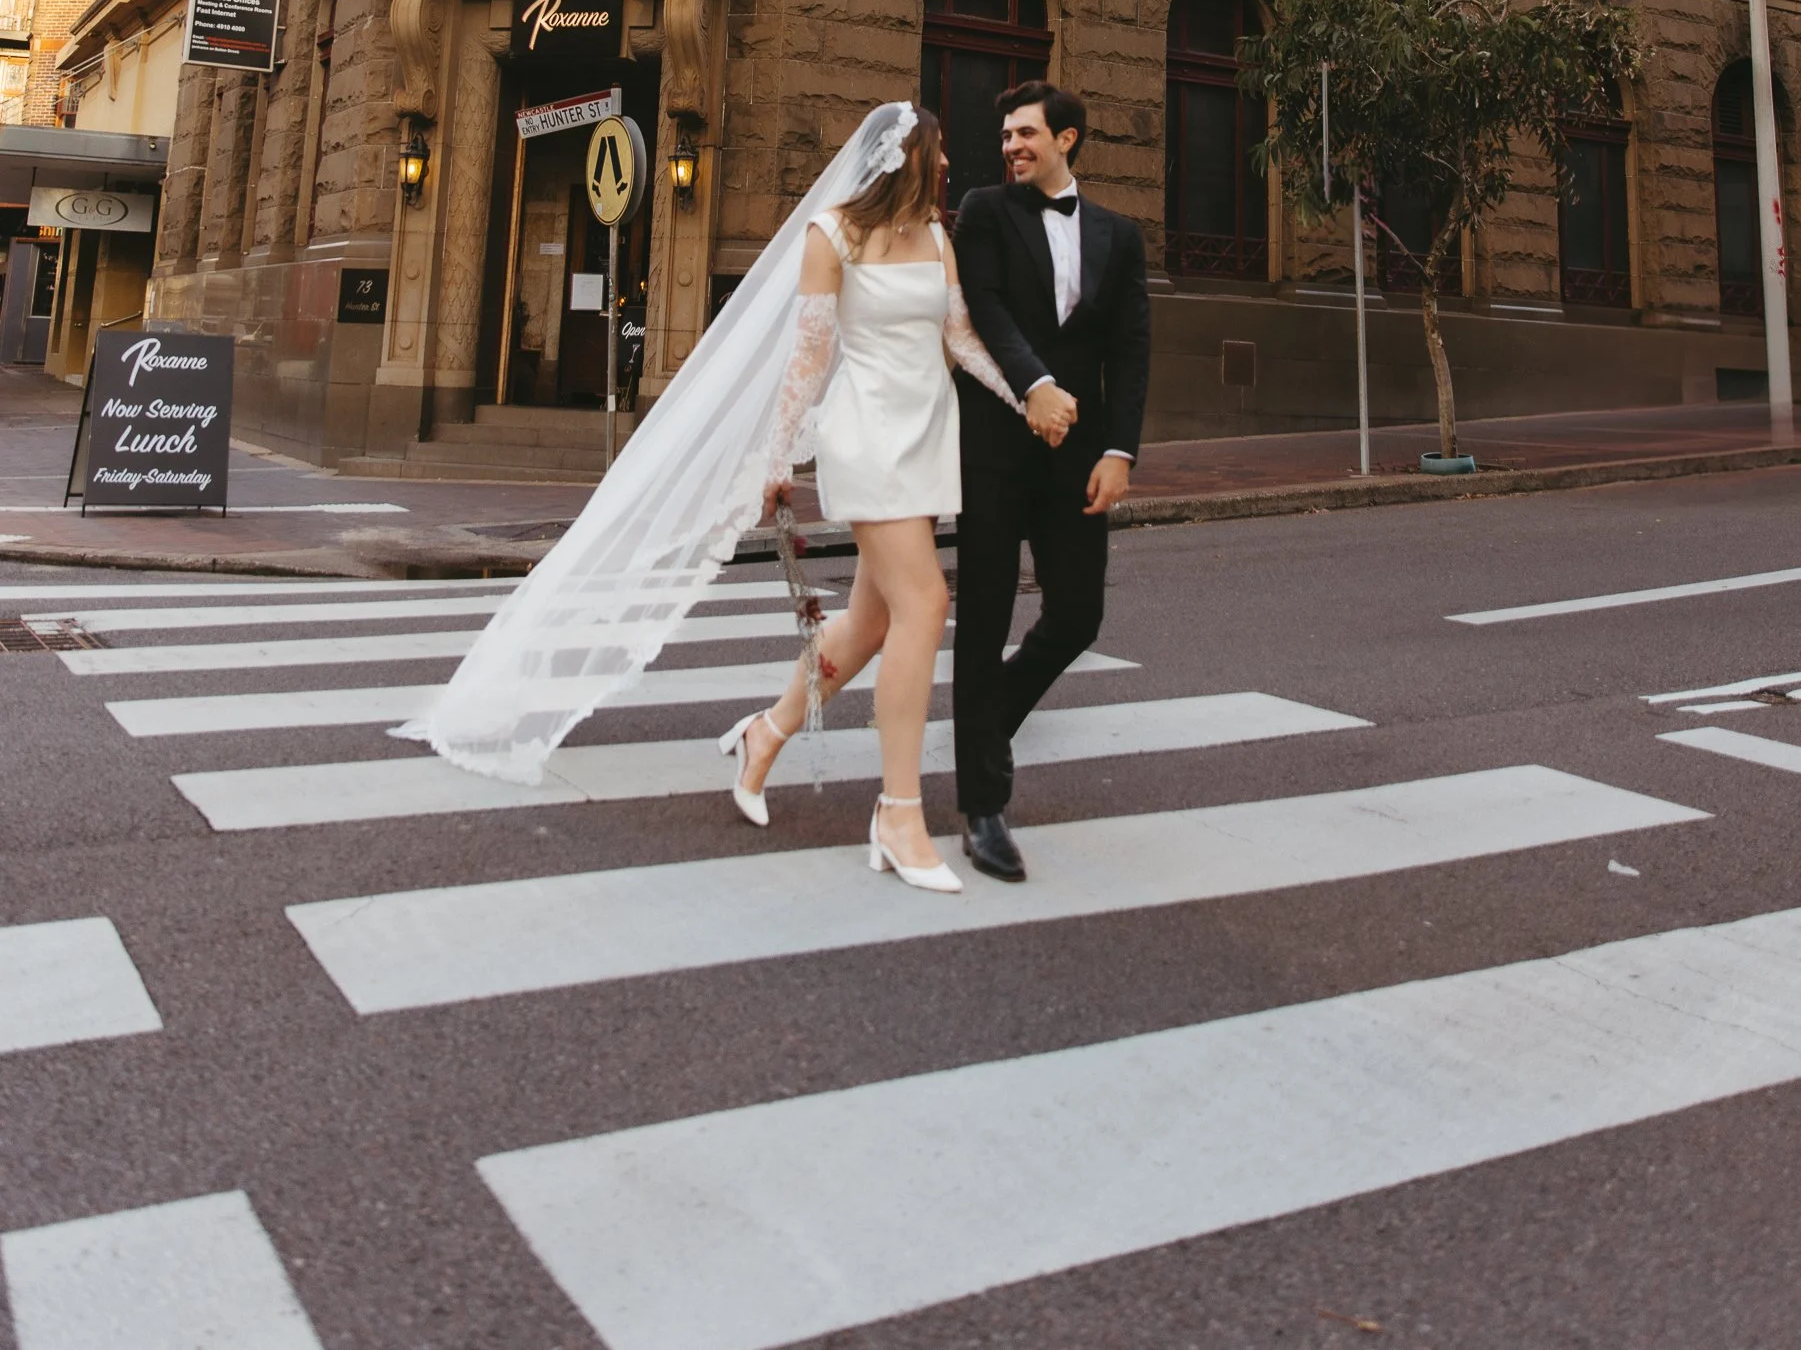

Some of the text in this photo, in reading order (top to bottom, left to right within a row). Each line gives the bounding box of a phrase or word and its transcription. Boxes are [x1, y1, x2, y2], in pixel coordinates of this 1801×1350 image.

[196, 6, 237, 18] Fast Internet
[197, 0, 218, 8] Meeting
[224, 3, 253, 12] Conference
[194, 20, 216, 29] Phone:
[517, 104, 555, 119] NEWCASTLE
[540, 106, 585, 130] HUNTER
[588, 101, 601, 118] ST
[525, 117, 534, 125] NO
[521, 124, 540, 135] ENTRY
[356, 280, 373, 294] 73
[622, 321, 646, 339] Open
[121, 337, 208, 387] Roxanne
[101, 398, 218, 428] Now Serving
[114, 424, 198, 454] Lunch
[93, 467, 212, 491] Friday-Saturday
